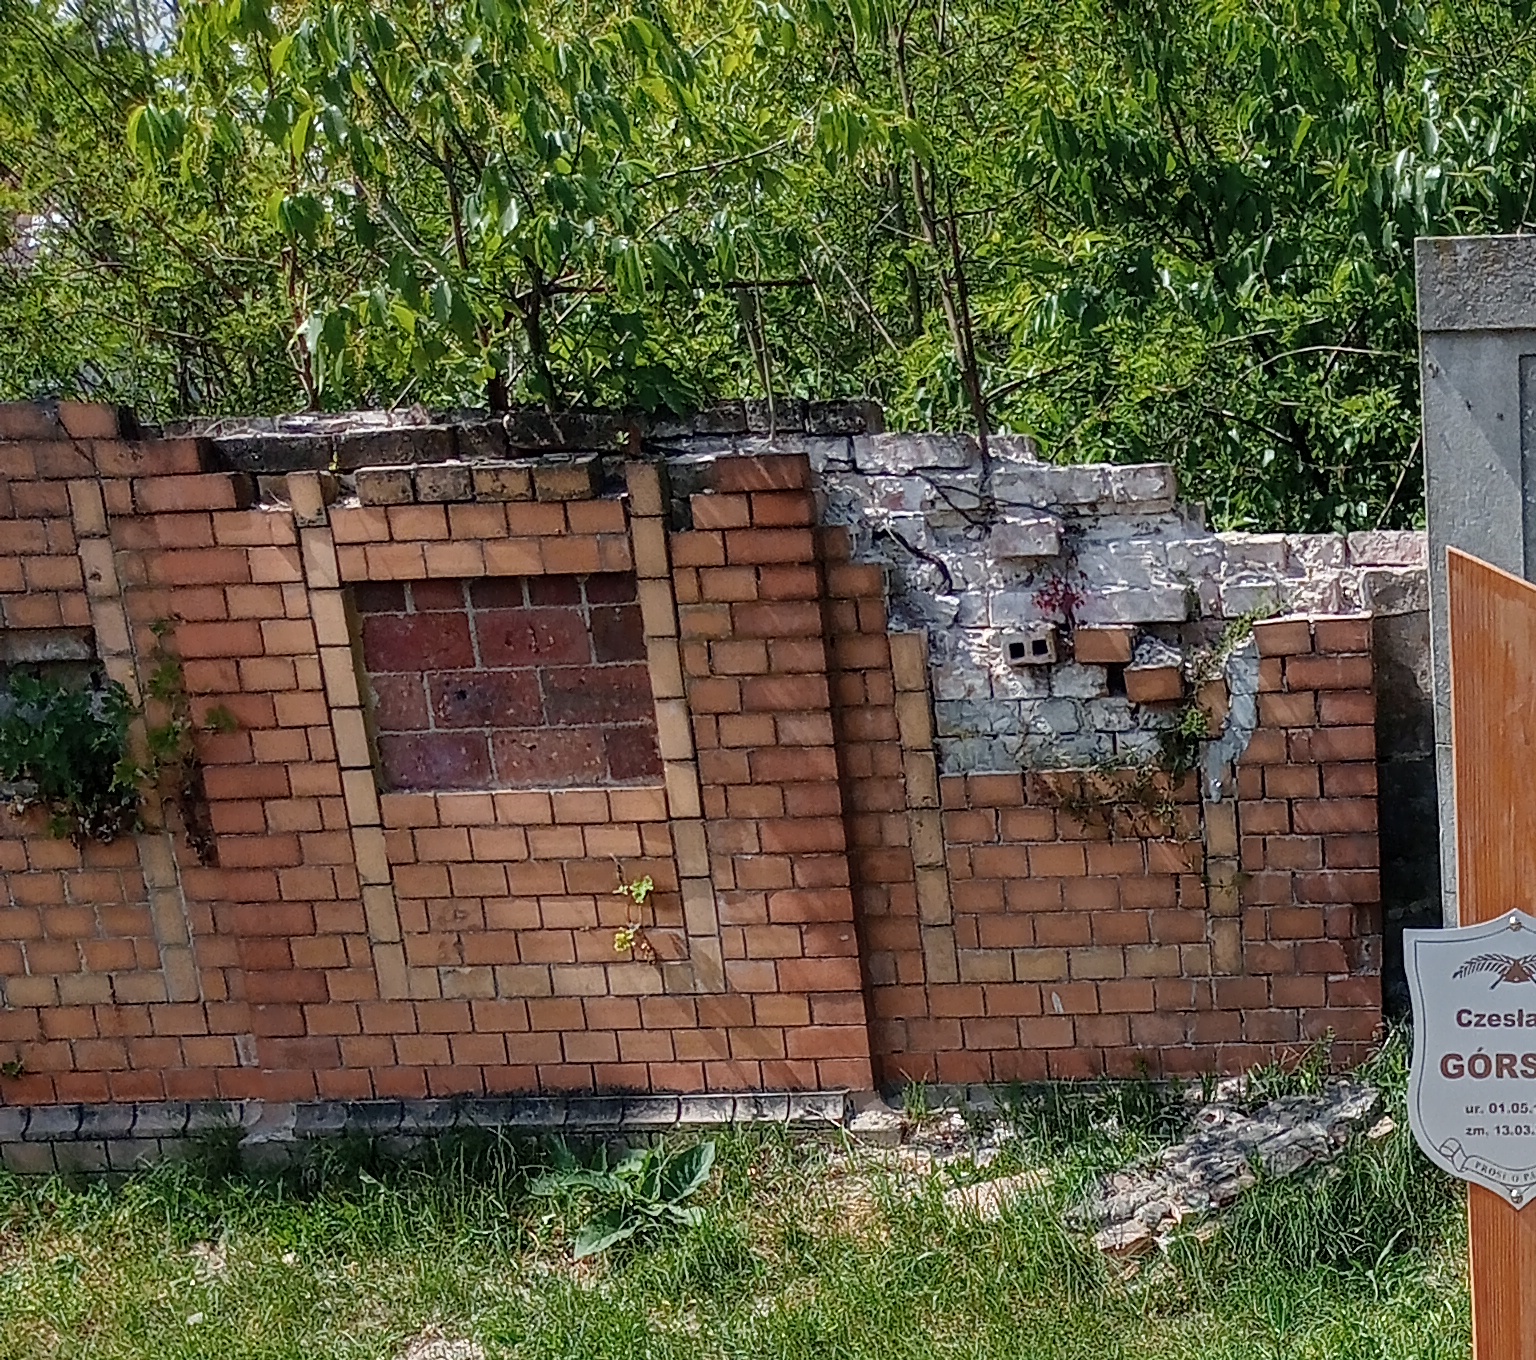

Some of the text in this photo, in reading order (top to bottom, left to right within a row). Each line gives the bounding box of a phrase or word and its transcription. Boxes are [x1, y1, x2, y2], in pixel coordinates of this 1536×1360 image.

[1465, 1104, 1485, 1115] ur.
[1465, 1126, 1489, 1137] zm.
[1511, 1174, 1520, 1182] O
